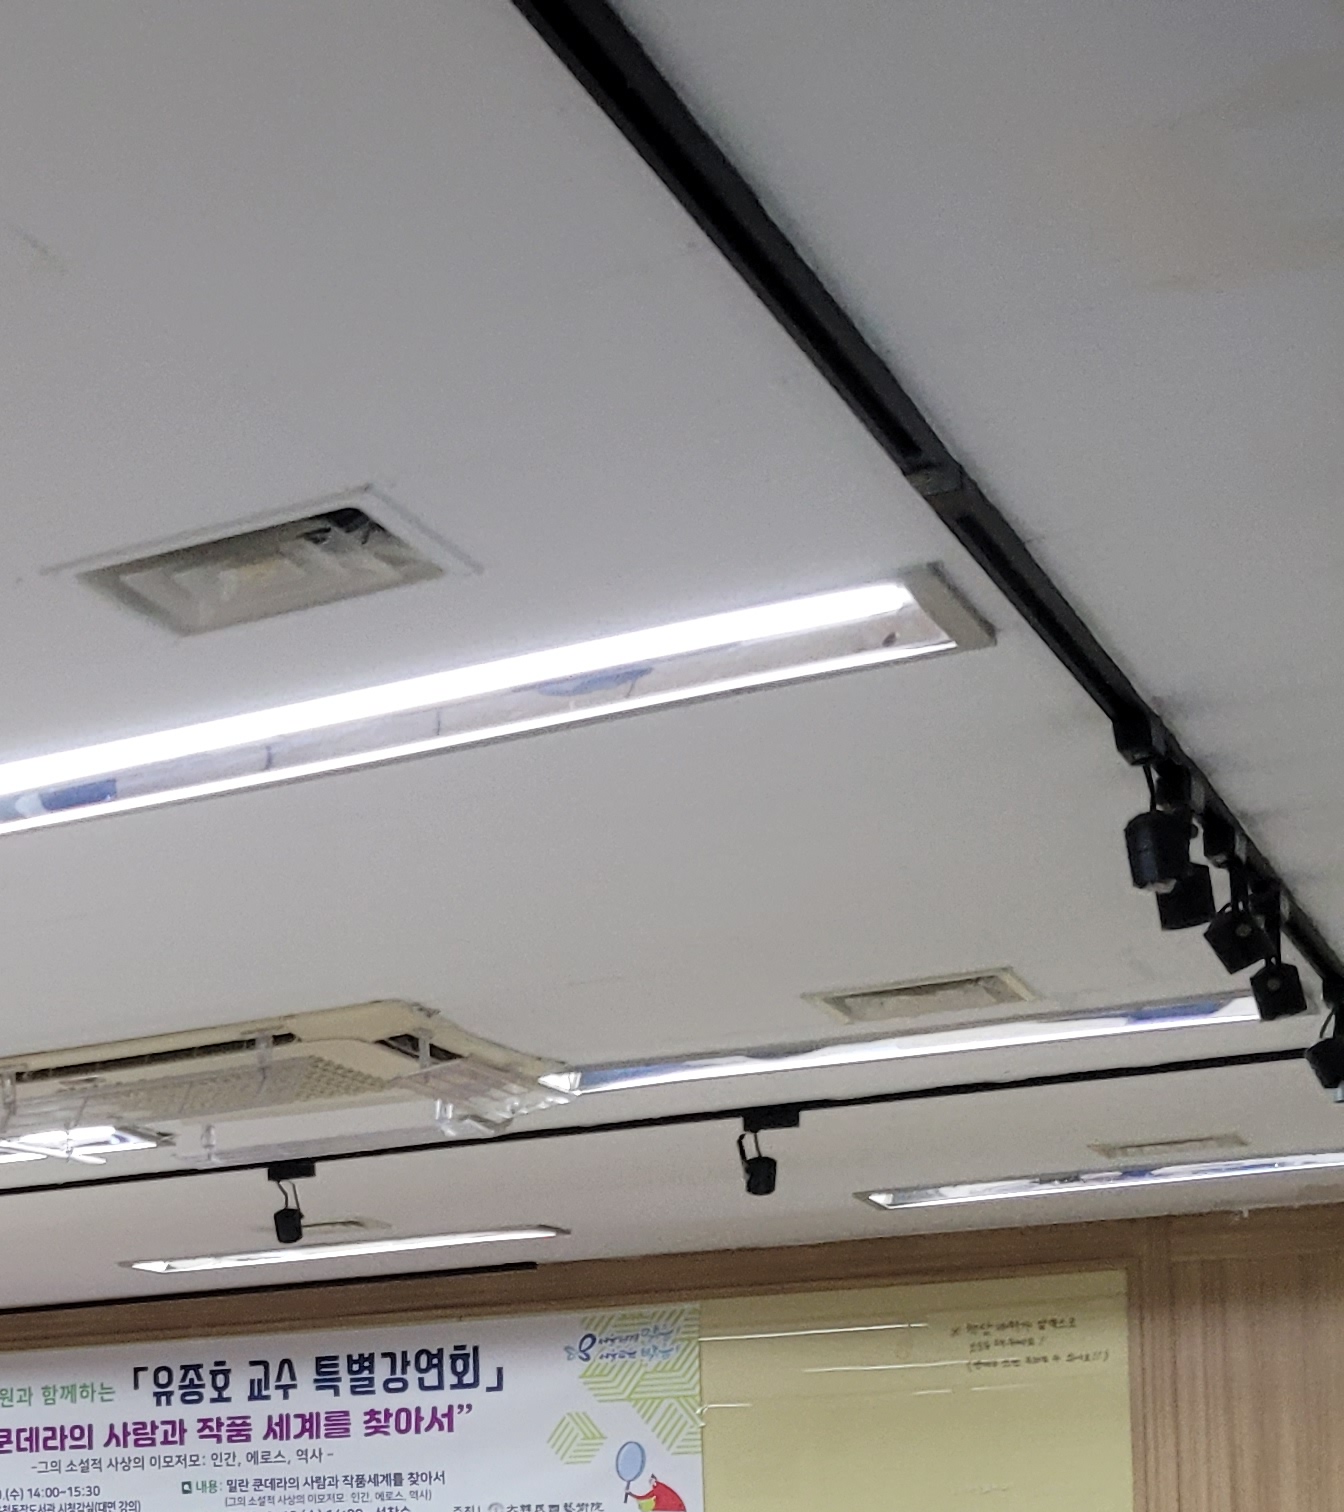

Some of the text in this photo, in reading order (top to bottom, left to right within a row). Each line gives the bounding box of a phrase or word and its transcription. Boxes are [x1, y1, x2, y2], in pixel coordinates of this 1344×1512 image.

[40, 1382, 116, 1406] 함께하는
[247, 1357, 299, 1402] 교수
[103, 1418, 188, 1449] 사람과
[196, 1414, 253, 1444] 작품
[262, 1410, 352, 1440] 세계를
[362, 1403, 473, 1438] 찾아서”
[65, 1457, 103, 1473] 소설적
[106, 1455, 145, 1472] 사상의
[149, 1453, 206, 1470] 이모저모:
[210, 1451, 242, 1468] 인간,
[245, 1449, 291, 1466] 에로스,
[295, 1447, 323, 1464] 역사
[196, 1470, 447, 1493] 내용: 밀란 쿤데라의 사람과 작품세계를 찾아서
